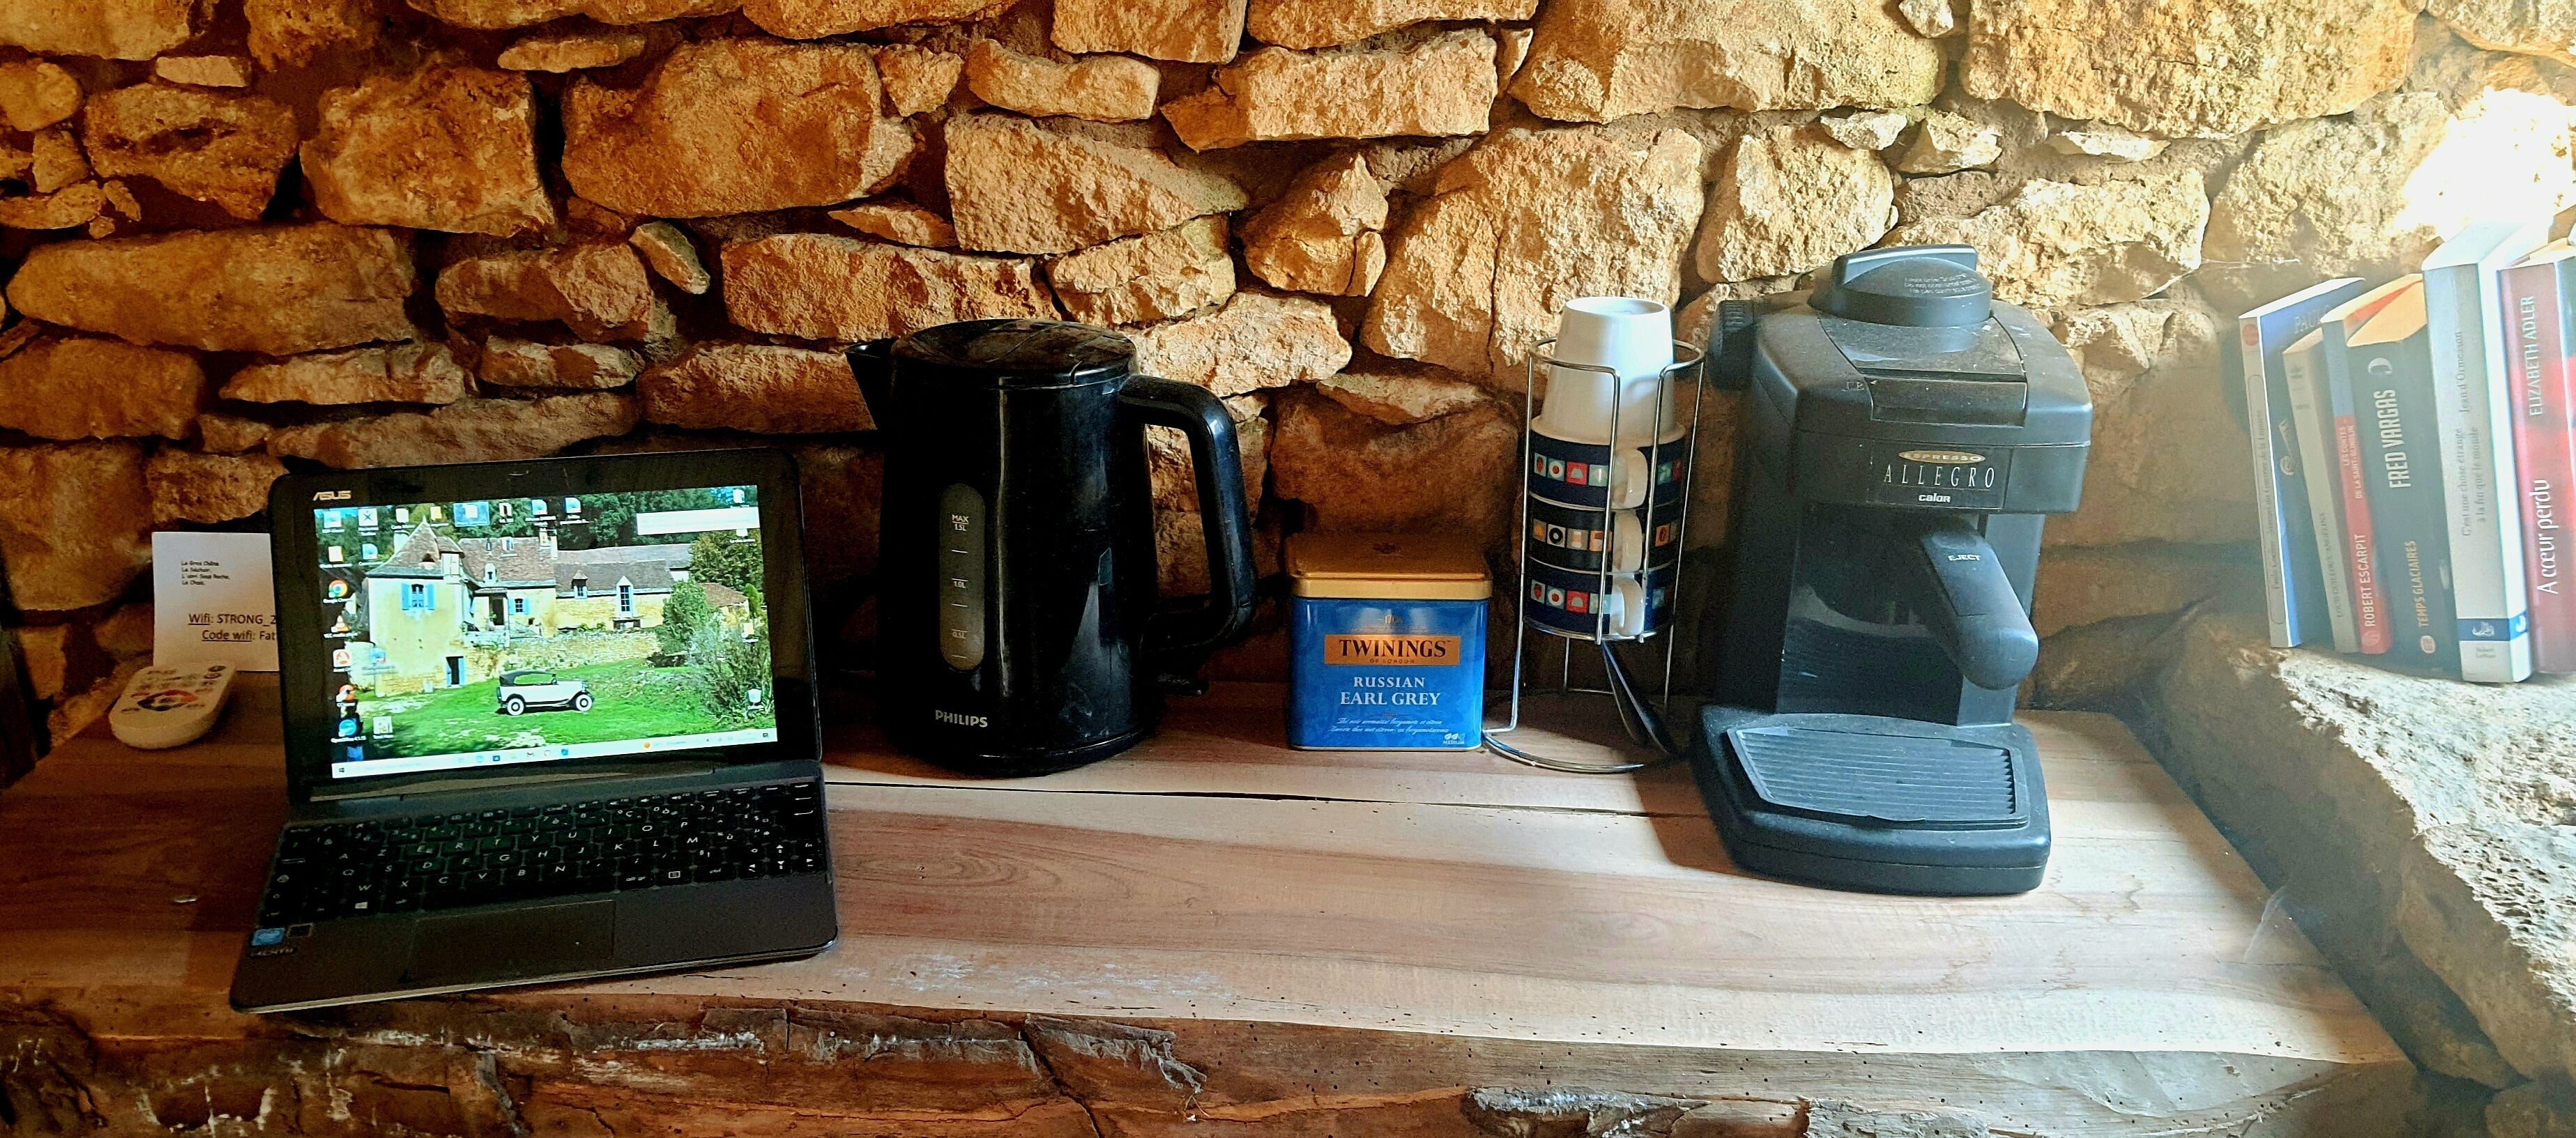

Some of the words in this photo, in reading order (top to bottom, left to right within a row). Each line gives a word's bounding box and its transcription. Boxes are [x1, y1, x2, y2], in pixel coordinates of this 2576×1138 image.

[2520, 295, 2538, 340] ADLER
[2524, 344, 2543, 416] ELIZABETH
[2374, 389, 2404, 448] VARGAS
[1883, 463, 1995, 489] ALLEGRO
[2384, 452, 2411, 489] FRED
[313, 490, 351, 501] ASUS
[2529, 479, 2559, 529] perdu
[2354, 534, 2371, 584] ESCARPIT
[2405, 540, 2425, 594] GLACIAIRES
[2536, 580, 2559, 594] A
[188, 613, 213, 624] Wifi:
[217, 614, 276, 626] STRONG_2
[2361, 587, 2376, 626] ROBERT
[2415, 597, 2429, 627] TEMPS
[202, 629, 229, 640] Code
[232, 630, 255, 640] wifi:
[1339, 639, 1447, 659] TWININGS
[1353, 677, 1426, 689] RUSSIAN
[1339, 691, 1387, 705] EARL
[1392, 691, 1441, 705] GREY
[935, 709, 989, 728] PHILIPS
